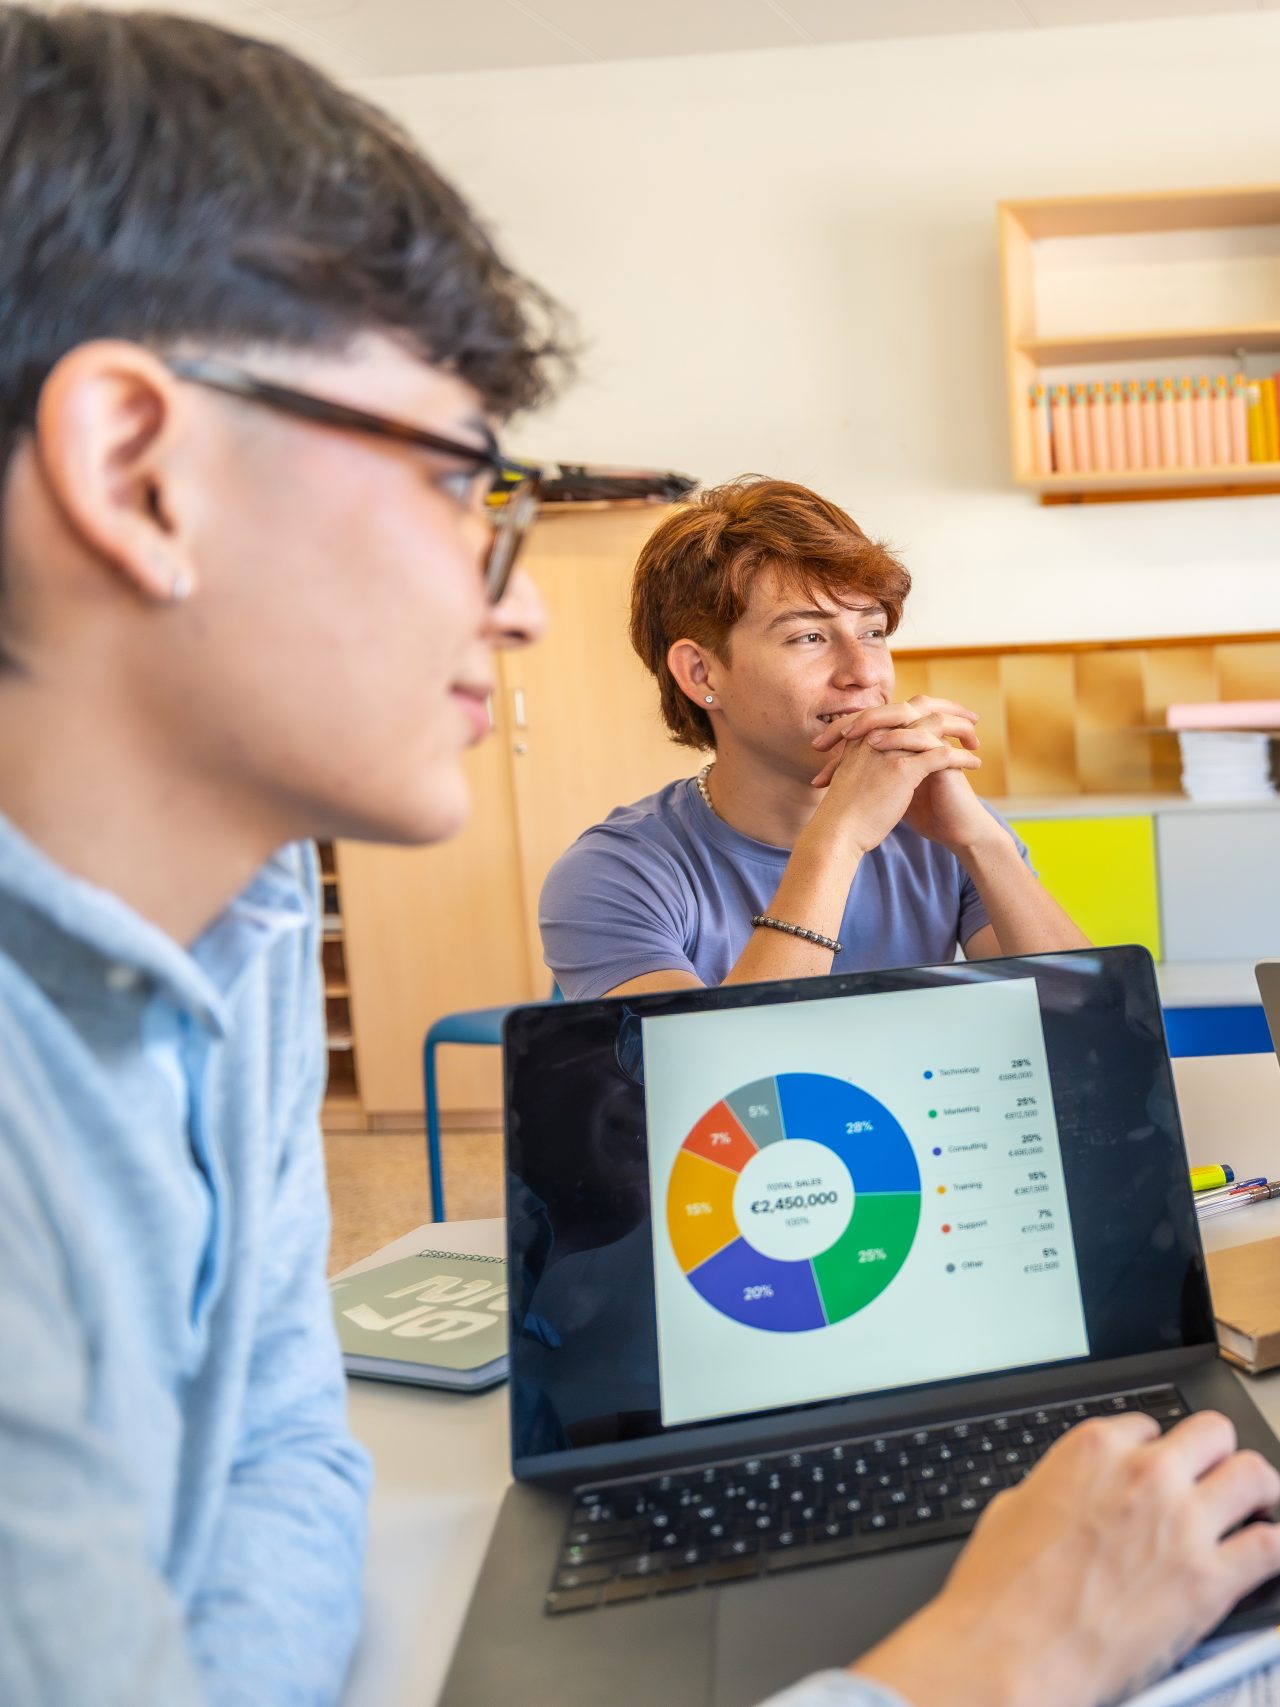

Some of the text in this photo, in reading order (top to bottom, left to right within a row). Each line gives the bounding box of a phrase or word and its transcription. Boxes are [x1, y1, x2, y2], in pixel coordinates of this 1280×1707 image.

[940, 1066, 980, 1077] Technology
[748, 1104, 769, 1118] 5%
[943, 1105, 980, 1116] Marketing
[845, 1120, 874, 1135] 28%
[710, 1132, 732, 1146] 7%
[948, 1142, 988, 1153] Consulting
[767, 1177, 822, 1192] TOTAL SALES
[685, 1202, 713, 1217] 15%
[750, 1190, 838, 1215] €2,450,000
[857, 1248, 887, 1264] 25%
[742, 1284, 774, 1301] 20%
